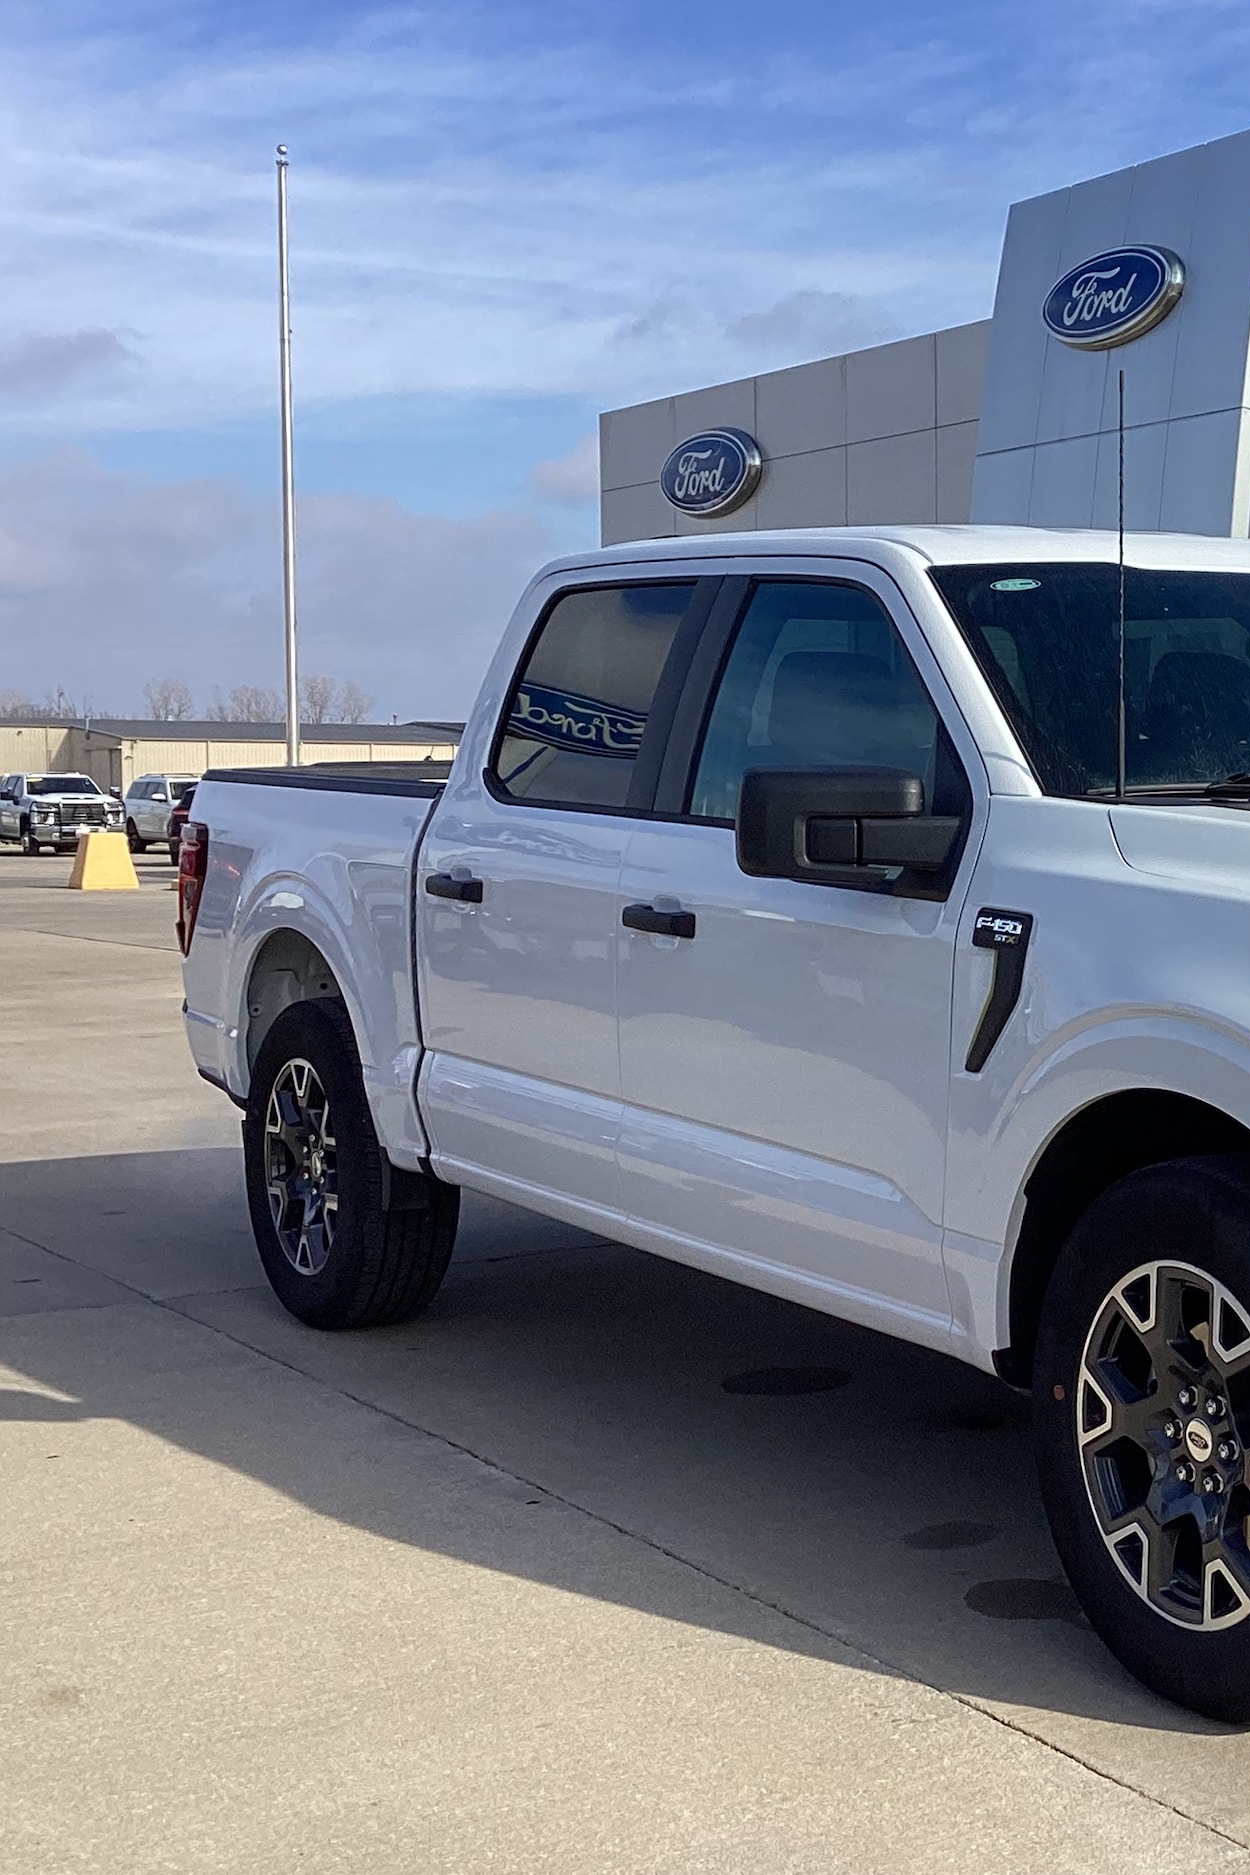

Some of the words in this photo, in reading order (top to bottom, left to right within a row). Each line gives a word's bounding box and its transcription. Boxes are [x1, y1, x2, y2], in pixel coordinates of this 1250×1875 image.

[1063, 266, 1138, 326] Ford
[674, 449, 726, 499] Ford
[976, 916, 1023, 935] F-150
[993, 934, 1016, 944] STX
